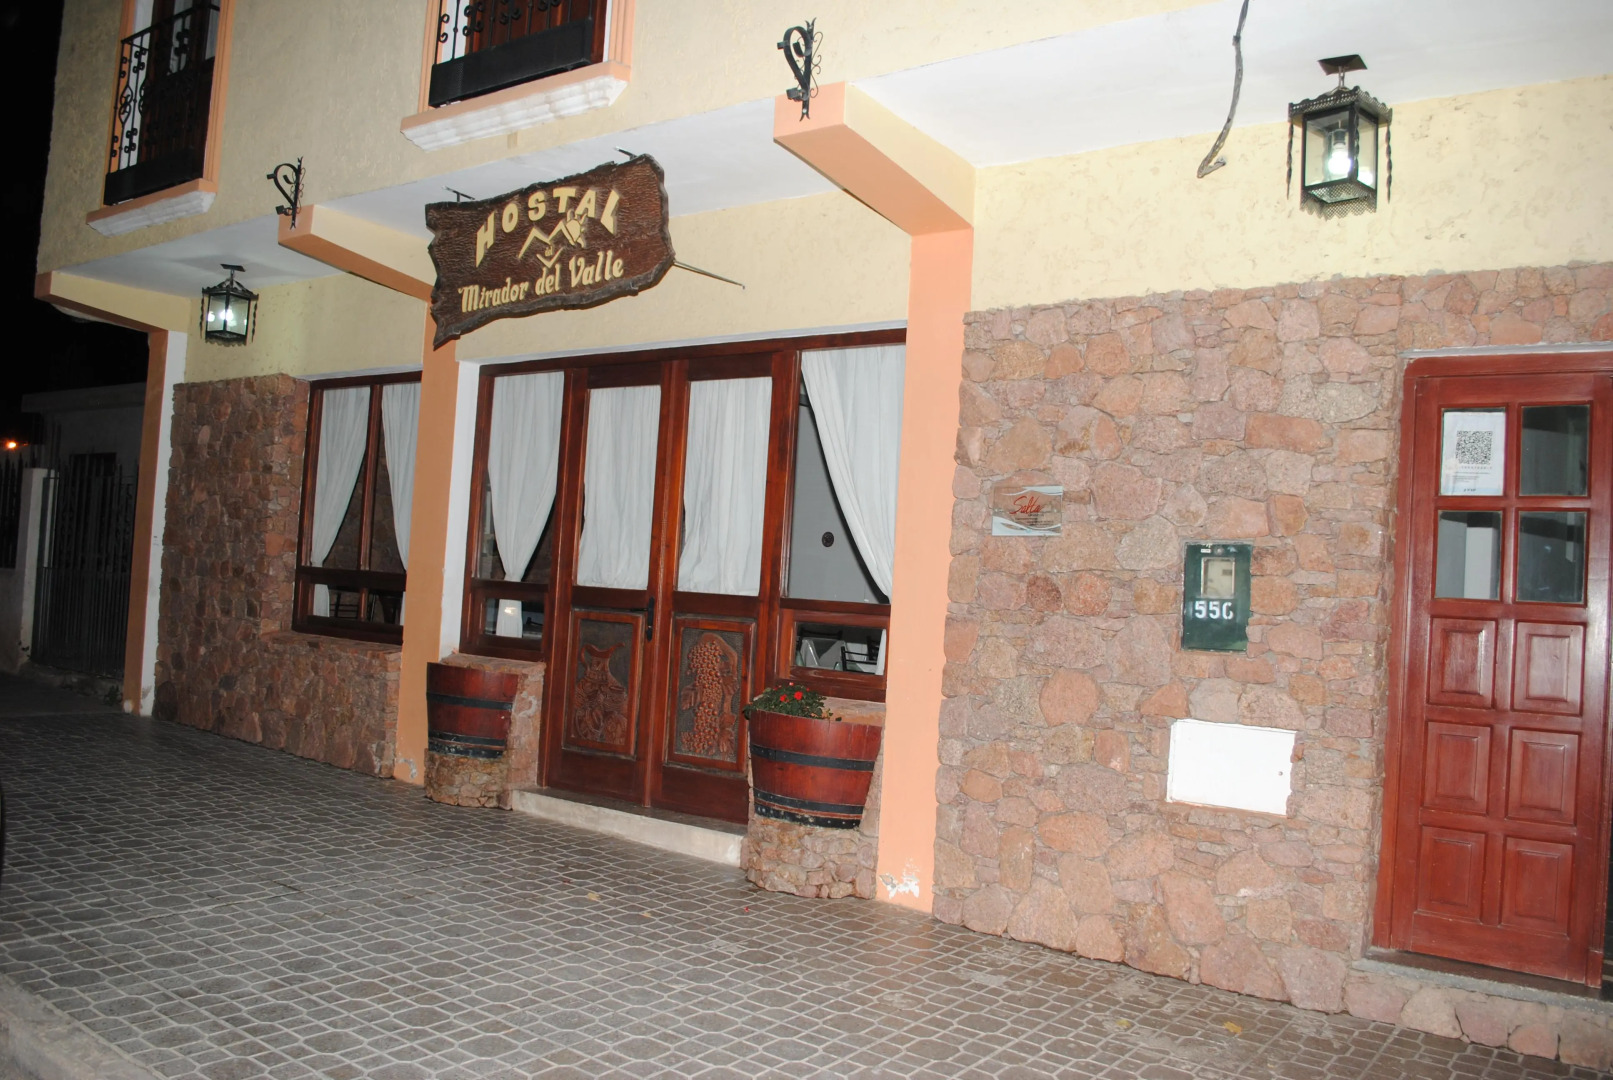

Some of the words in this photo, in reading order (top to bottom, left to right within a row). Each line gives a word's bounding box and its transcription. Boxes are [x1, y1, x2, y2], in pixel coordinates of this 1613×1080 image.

[476, 187, 620, 267] HOSTAL
[458, 277, 528, 313] Mirador
[535, 263, 560, 296] del
[569, 250, 624, 288] Valle
[1009, 495, 1042, 514] Salta
